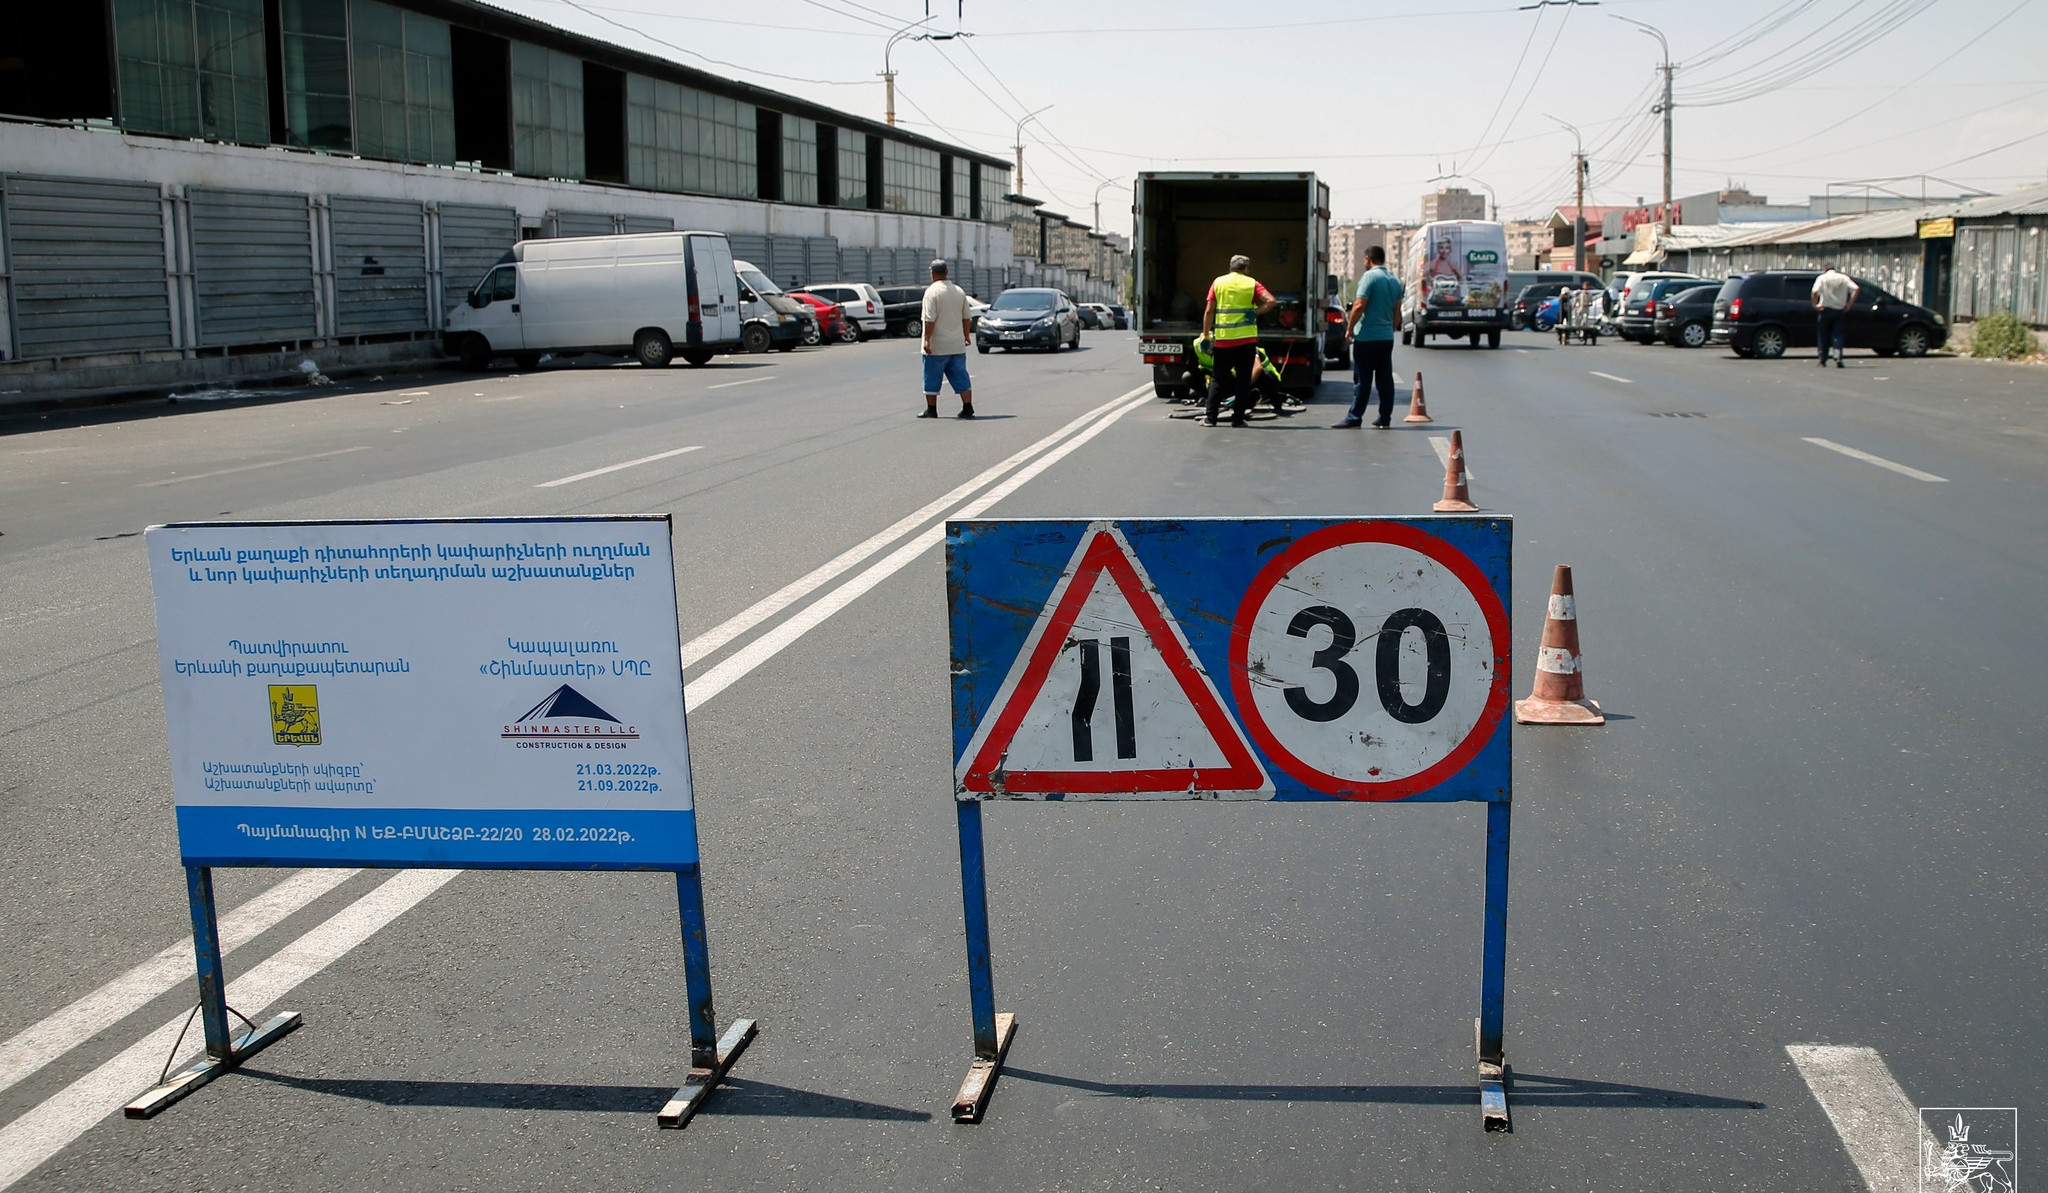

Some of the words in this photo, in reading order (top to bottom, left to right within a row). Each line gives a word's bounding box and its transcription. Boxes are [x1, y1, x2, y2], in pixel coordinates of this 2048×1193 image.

[171, 547, 232, 564] Երևան
[236, 546, 309, 564] քաղաքի
[314, 544, 432, 562] դիտահորերի
[437, 543, 567, 561] կափարիչների
[572, 542, 651, 560] ուղղման
[189, 567, 203, 582] և
[205, 567, 237, 584] նոր
[243, 565, 369, 584] կափարիչների
[374, 563, 486, 583] տեղադրման
[492, 563, 635, 581] աշխատանքներ
[228, 639, 350, 657] Պատվիրատու
[507, 637, 619, 657] Կապալառու
[174, 659, 242, 677] Երևանի
[246, 658, 410, 677] քաղաքապետարան
[479, 660, 606, 679] «Շինմաստեր»
[611, 660, 652, 676] ՍՊԸ
[1283, 605, 1452, 723] 30
[503, 725, 601, 734] SHINMASTER
[609, 726, 636, 734] LLC
[516, 741, 584, 750] CONSTRUCTION
[594, 742, 627, 750] DESIGN
[202, 761, 309, 777] Աշխատանքների
[576, 763, 662, 778] 21.03.2022թ.
[204, 777, 311, 793] Աշխատանքների
[577, 779, 663, 794] 21.09.2022թ.
[236, 823, 351, 842] Պայմանագիր
[355, 825, 367, 839] N
[532, 827, 636, 844] 28.02.2022թ.
